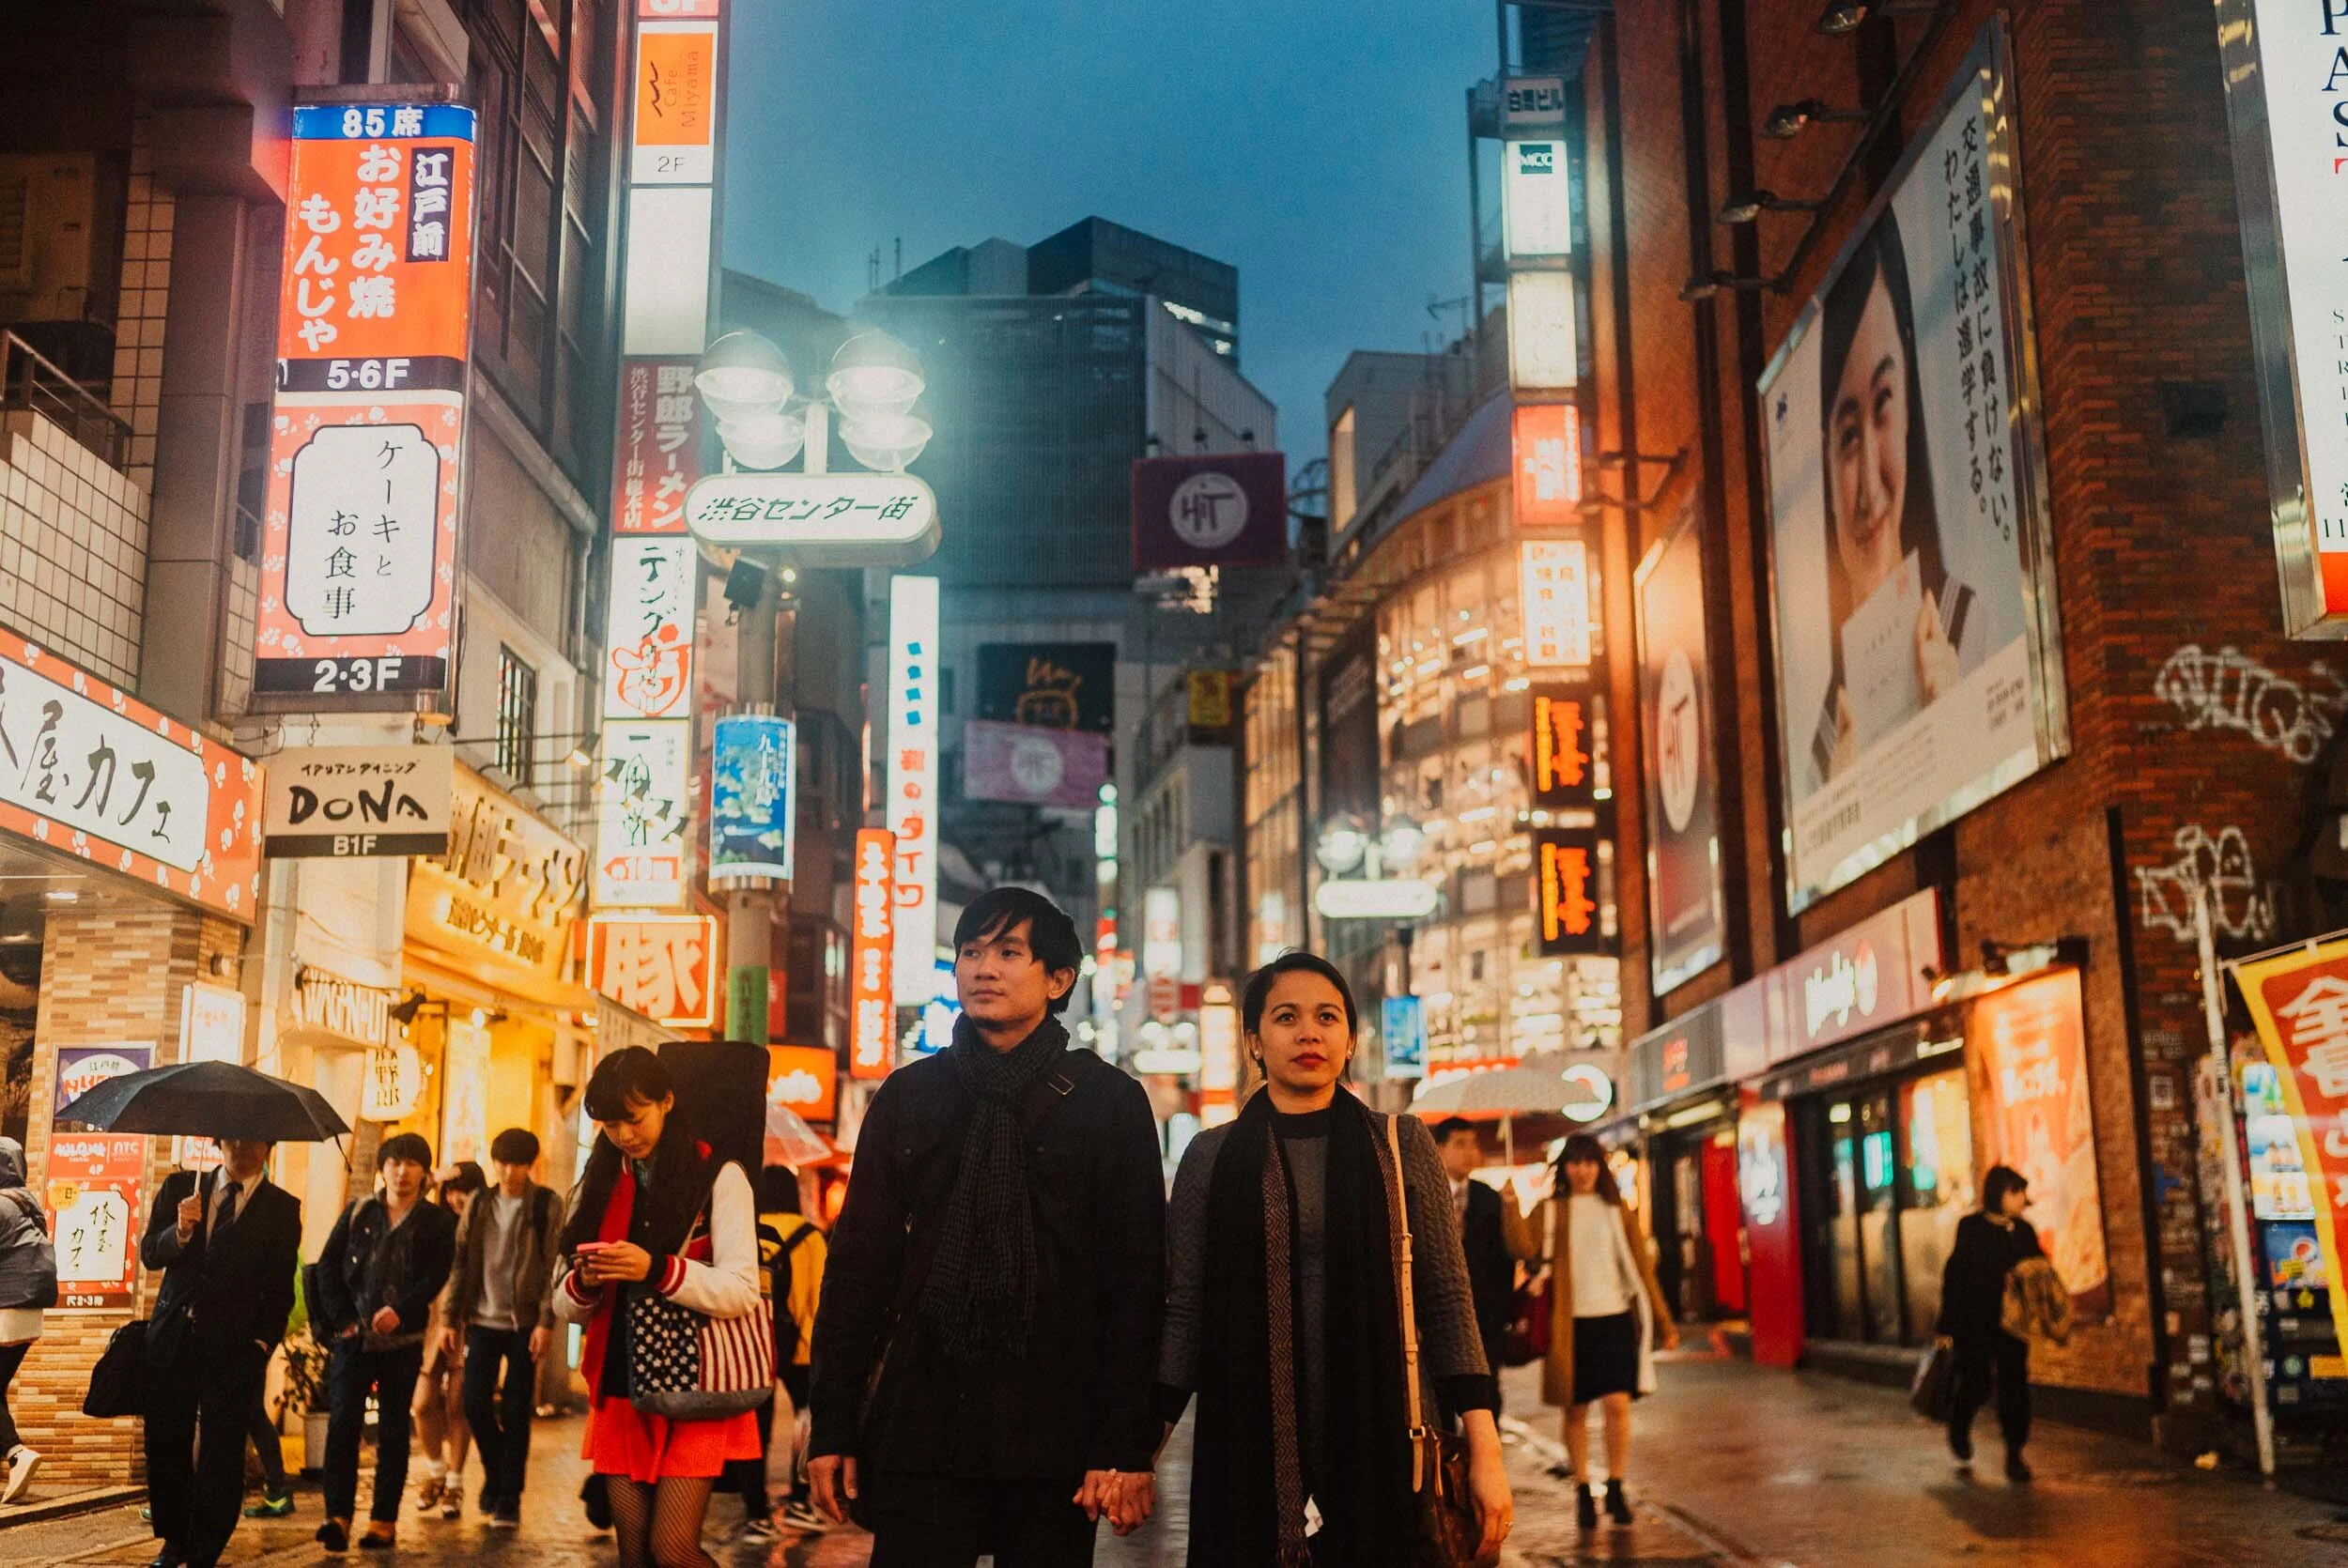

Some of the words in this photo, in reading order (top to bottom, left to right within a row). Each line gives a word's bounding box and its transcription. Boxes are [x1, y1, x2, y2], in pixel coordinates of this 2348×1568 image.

[342, 107, 424, 138] 85席
[663, 69, 678, 107] Cafe
[681, 51, 700, 128] Miyama
[411, 152, 450, 257] 江戸前
[657, 156, 686, 173] 2F
[347, 144, 402, 318] お好み焼
[651, 365, 695, 530] 野郎ラーメン
[372, 440, 403, 576] ケーキと
[698, 496, 919, 522] 渋谷センター街
[322, 510, 359, 620] お食事
[639, 546, 677, 640] テング
[332, 835, 378, 856] B1F
[599, 922, 703, 1019] 豚
